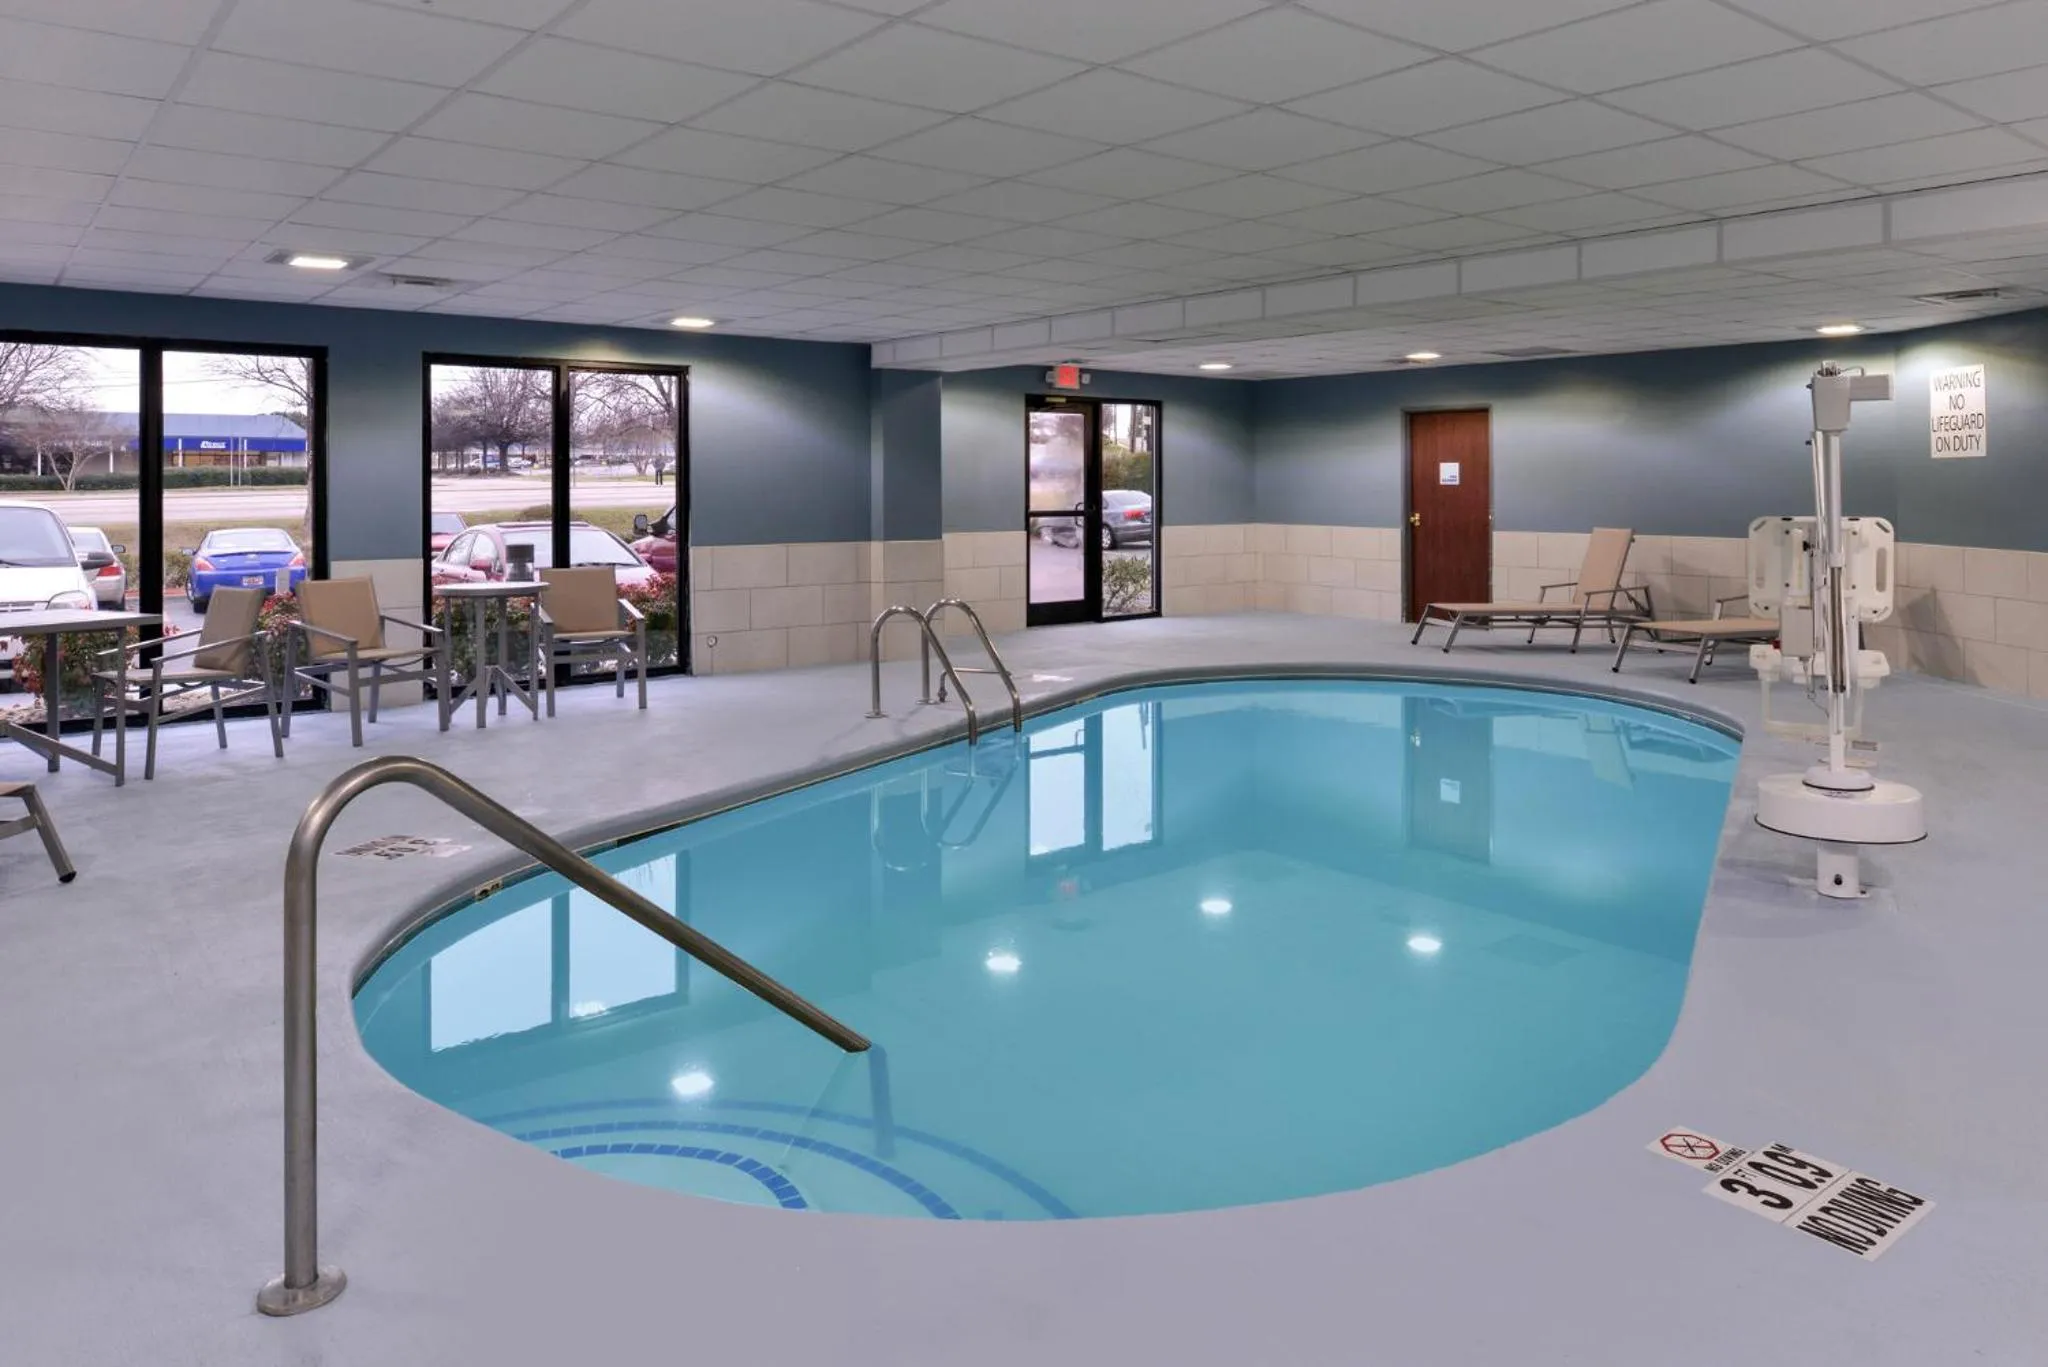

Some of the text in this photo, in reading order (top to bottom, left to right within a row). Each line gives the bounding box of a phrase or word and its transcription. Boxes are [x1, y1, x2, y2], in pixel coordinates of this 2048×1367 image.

[1933, 371, 1981, 391] WARNING
[1949, 394, 1965, 410] NO
[1932, 413, 1985, 432] LIFEGUARD
[1936, 434, 1981, 452] ON DUTY
[1747, 1151, 1833, 1189] 0.9
[1720, 1179, 1793, 1209] 3
[1796, 1178, 1925, 1255] NO DIVING
